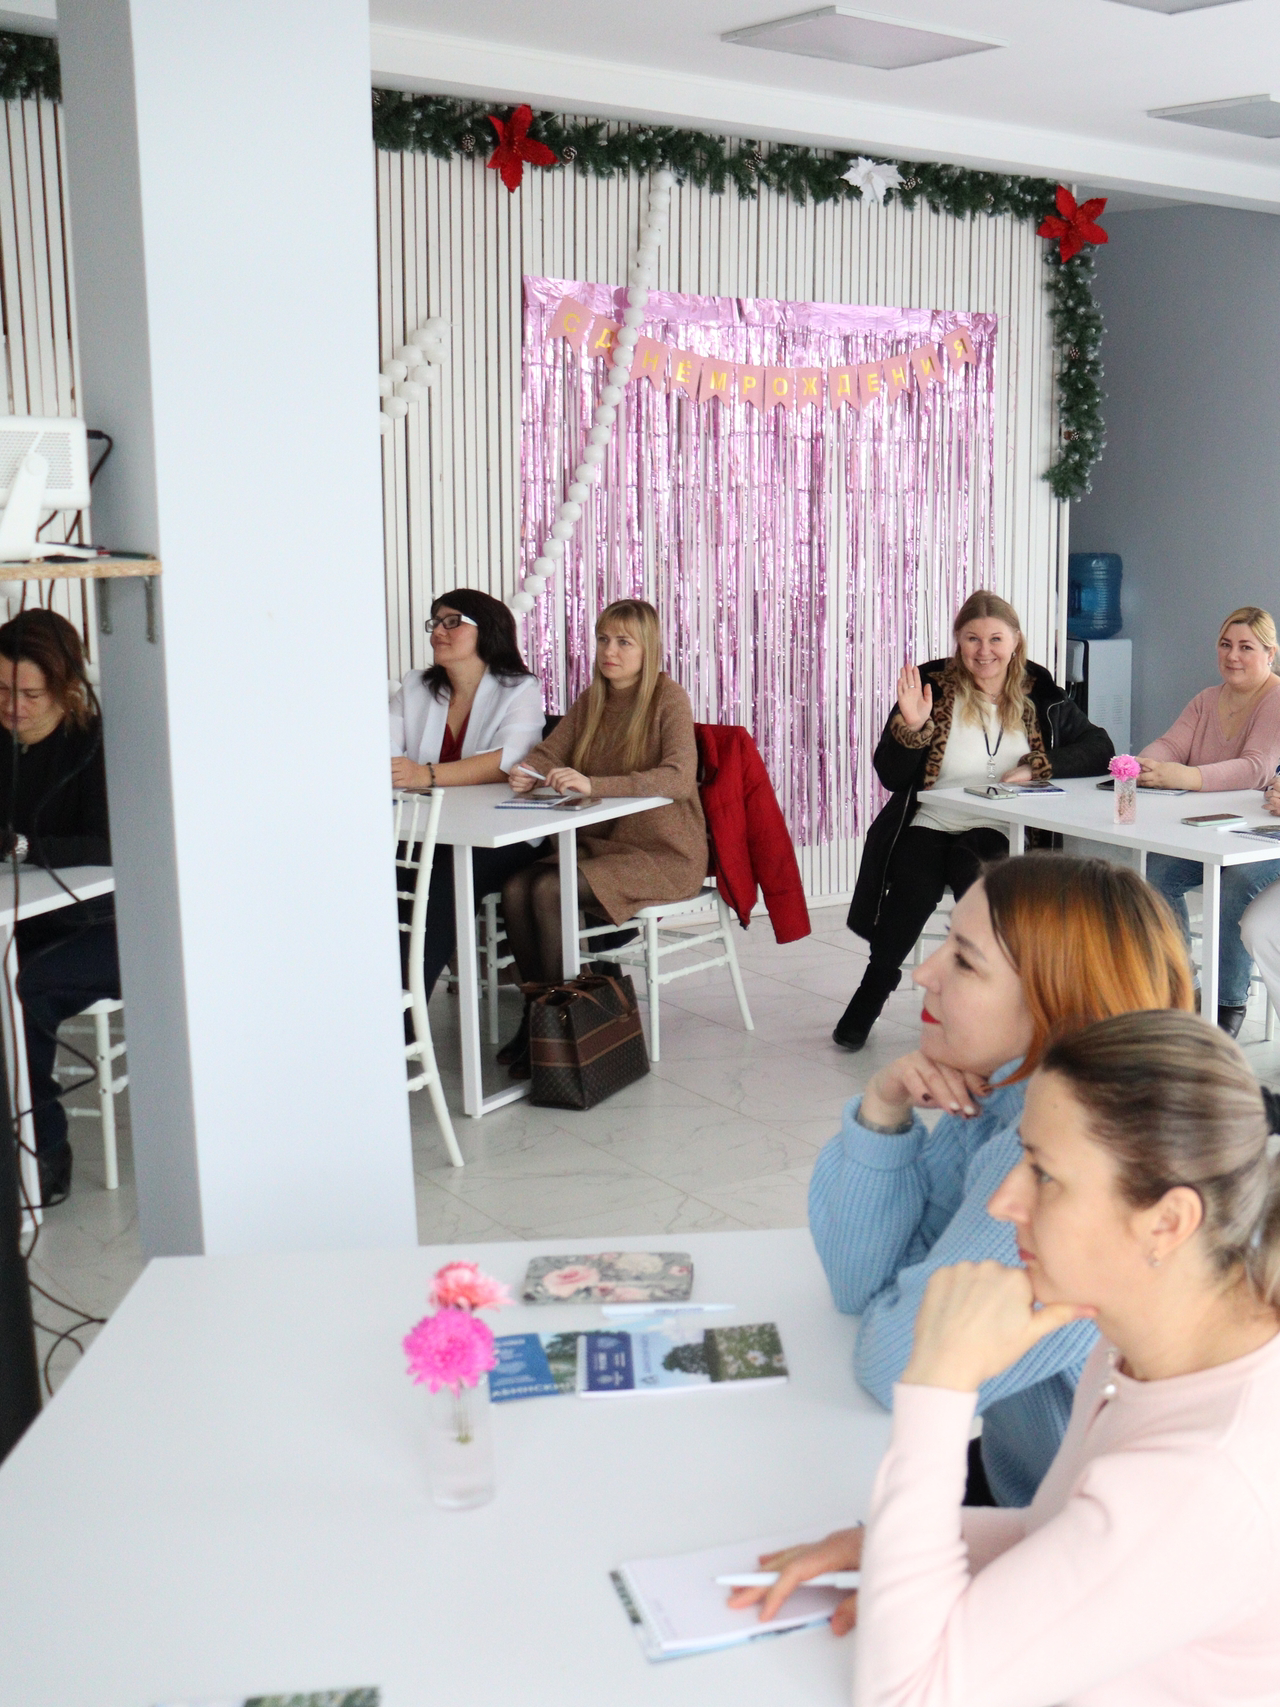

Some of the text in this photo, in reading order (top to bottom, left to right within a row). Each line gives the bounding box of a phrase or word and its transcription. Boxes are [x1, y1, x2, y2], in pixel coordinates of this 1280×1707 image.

[563, 312, 969, 396] С ДНЁМ РОЖДЕНИЯ
